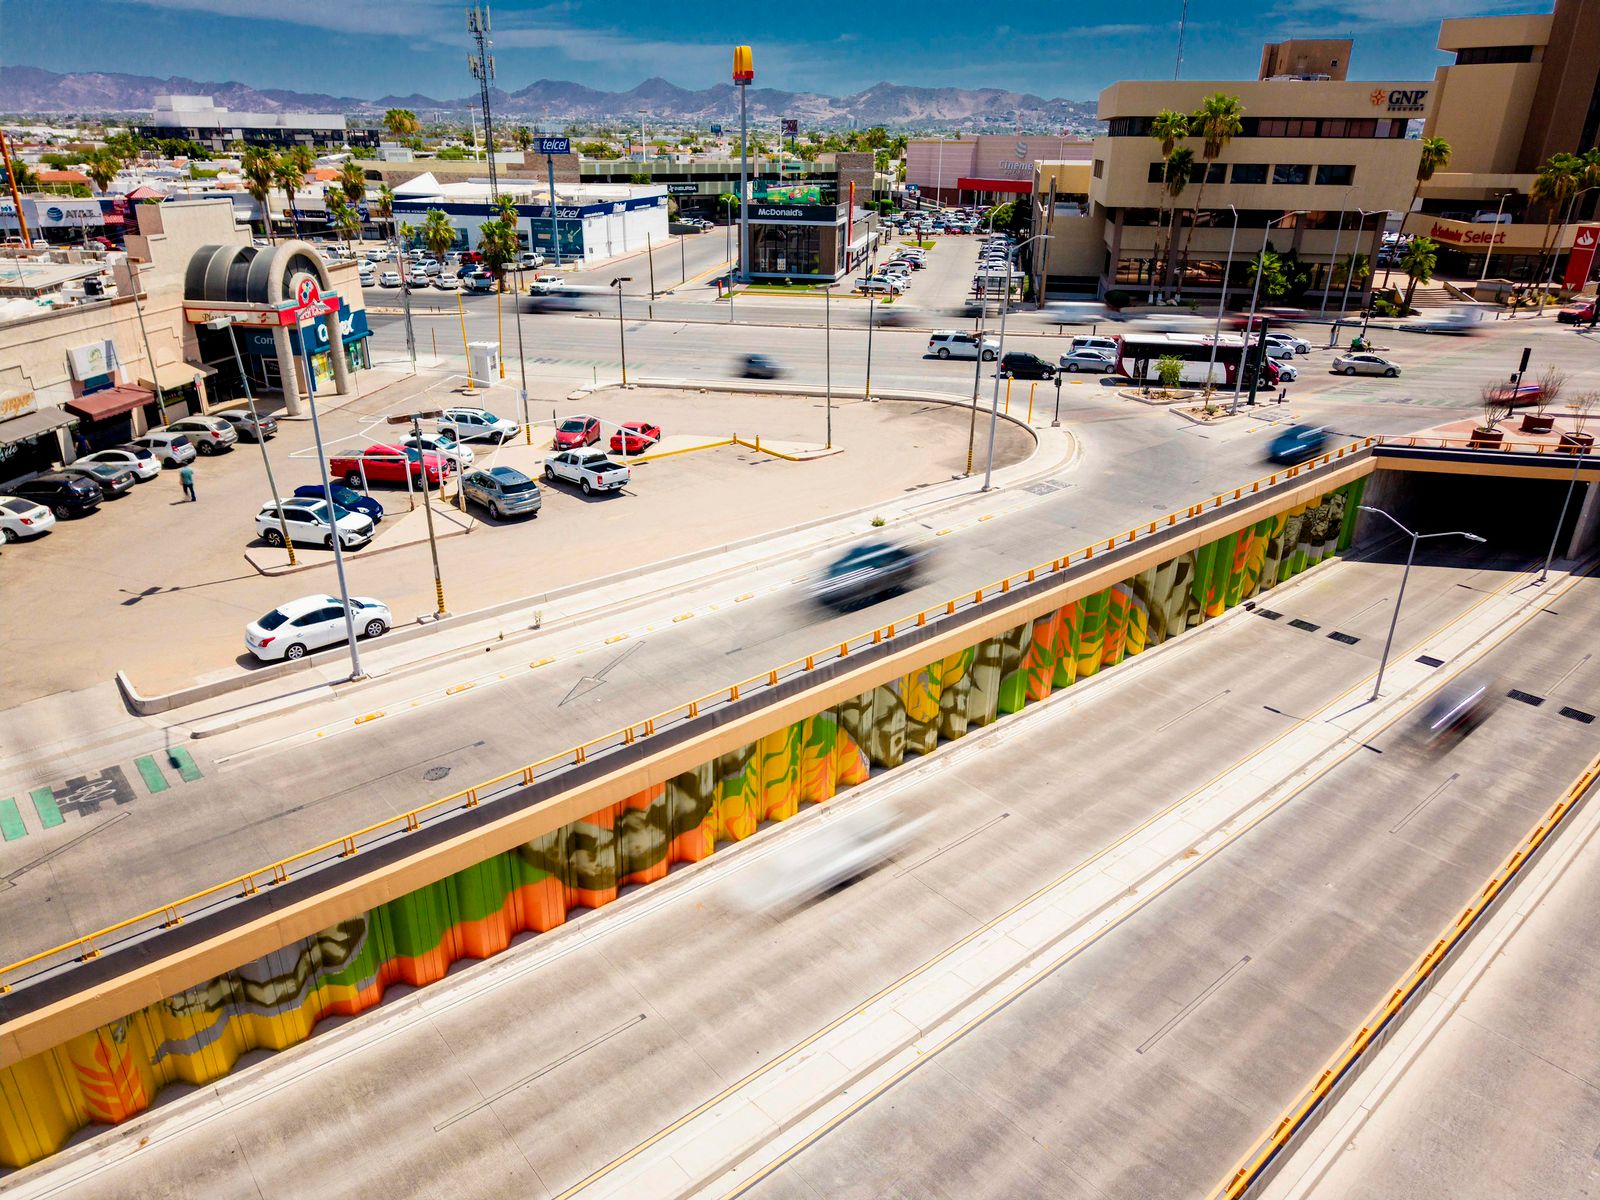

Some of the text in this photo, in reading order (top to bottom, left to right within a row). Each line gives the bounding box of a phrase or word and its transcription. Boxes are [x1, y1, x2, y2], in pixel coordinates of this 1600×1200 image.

[1388, 90, 1426, 105] GNP
[542, 139, 568, 150] telcel
[999, 160, 1033, 170] Cineme
[553, 207, 581, 218] elcel
[758, 208, 803, 217] McDonald's
[1463, 230, 1507, 244] Select
